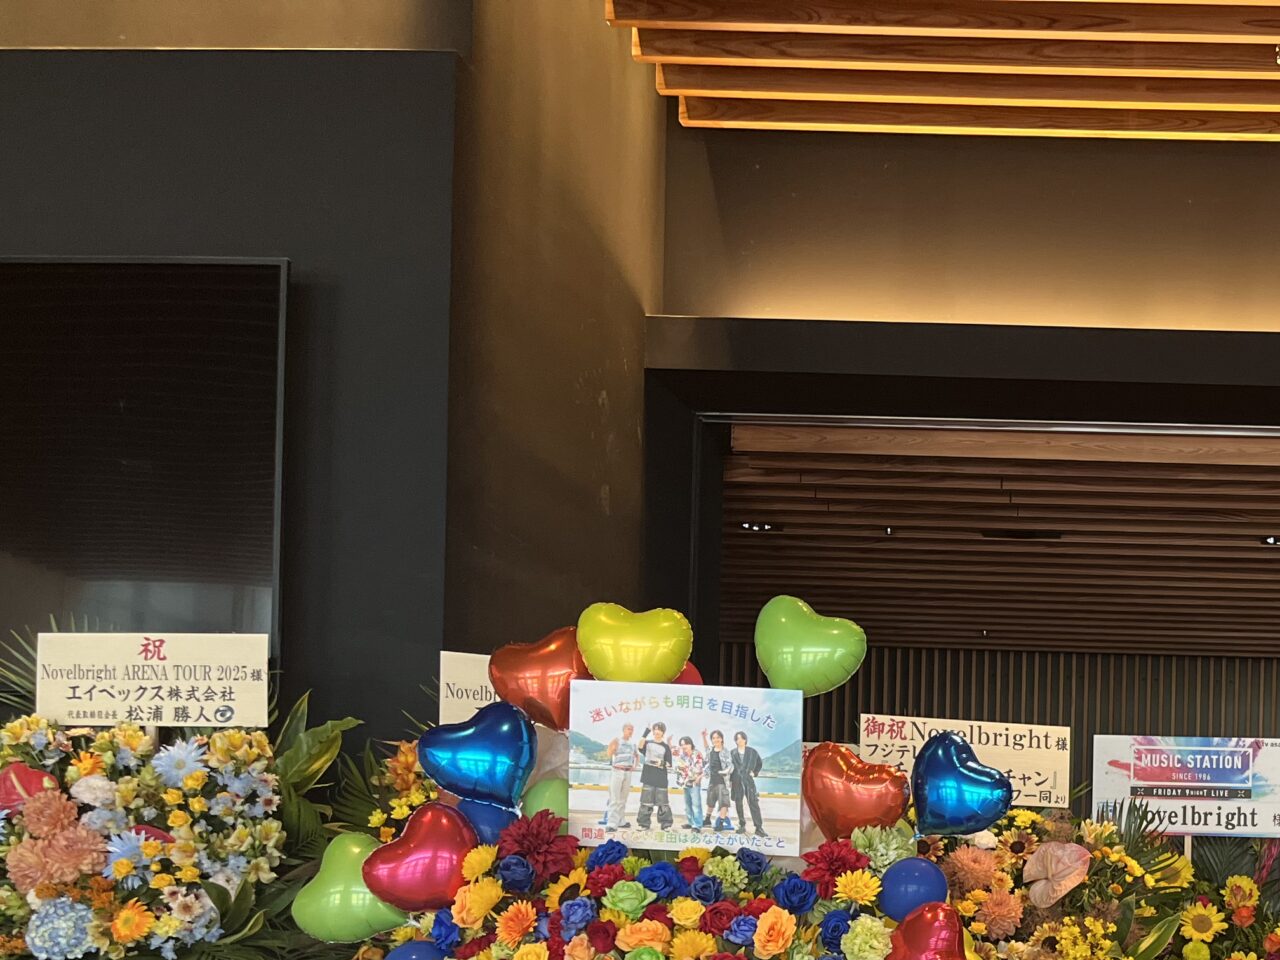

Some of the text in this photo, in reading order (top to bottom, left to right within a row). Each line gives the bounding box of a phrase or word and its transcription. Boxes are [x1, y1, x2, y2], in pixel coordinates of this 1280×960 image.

[138, 636, 167, 661] 祝
[41, 664, 264, 682] Novelbright ARENA TOUR 2025 様
[66, 684, 236, 702] エイベックス株式会社
[125, 704, 164, 722] 松浦
[173, 704, 212, 723] 勝人
[588, 695, 777, 731] 迷いながらも明日を目指した
[863, 716, 1069, 751] 御祝 Noelbright 様
[1141, 753, 1242, 769] MUSIC STATION
[1172, 772, 1191, 781] SINCE
[1153, 788, 1181, 796] FRIDAY
[1211, 789, 1229, 797] LIVE
[1135, 804, 1258, 830] ovelbright
